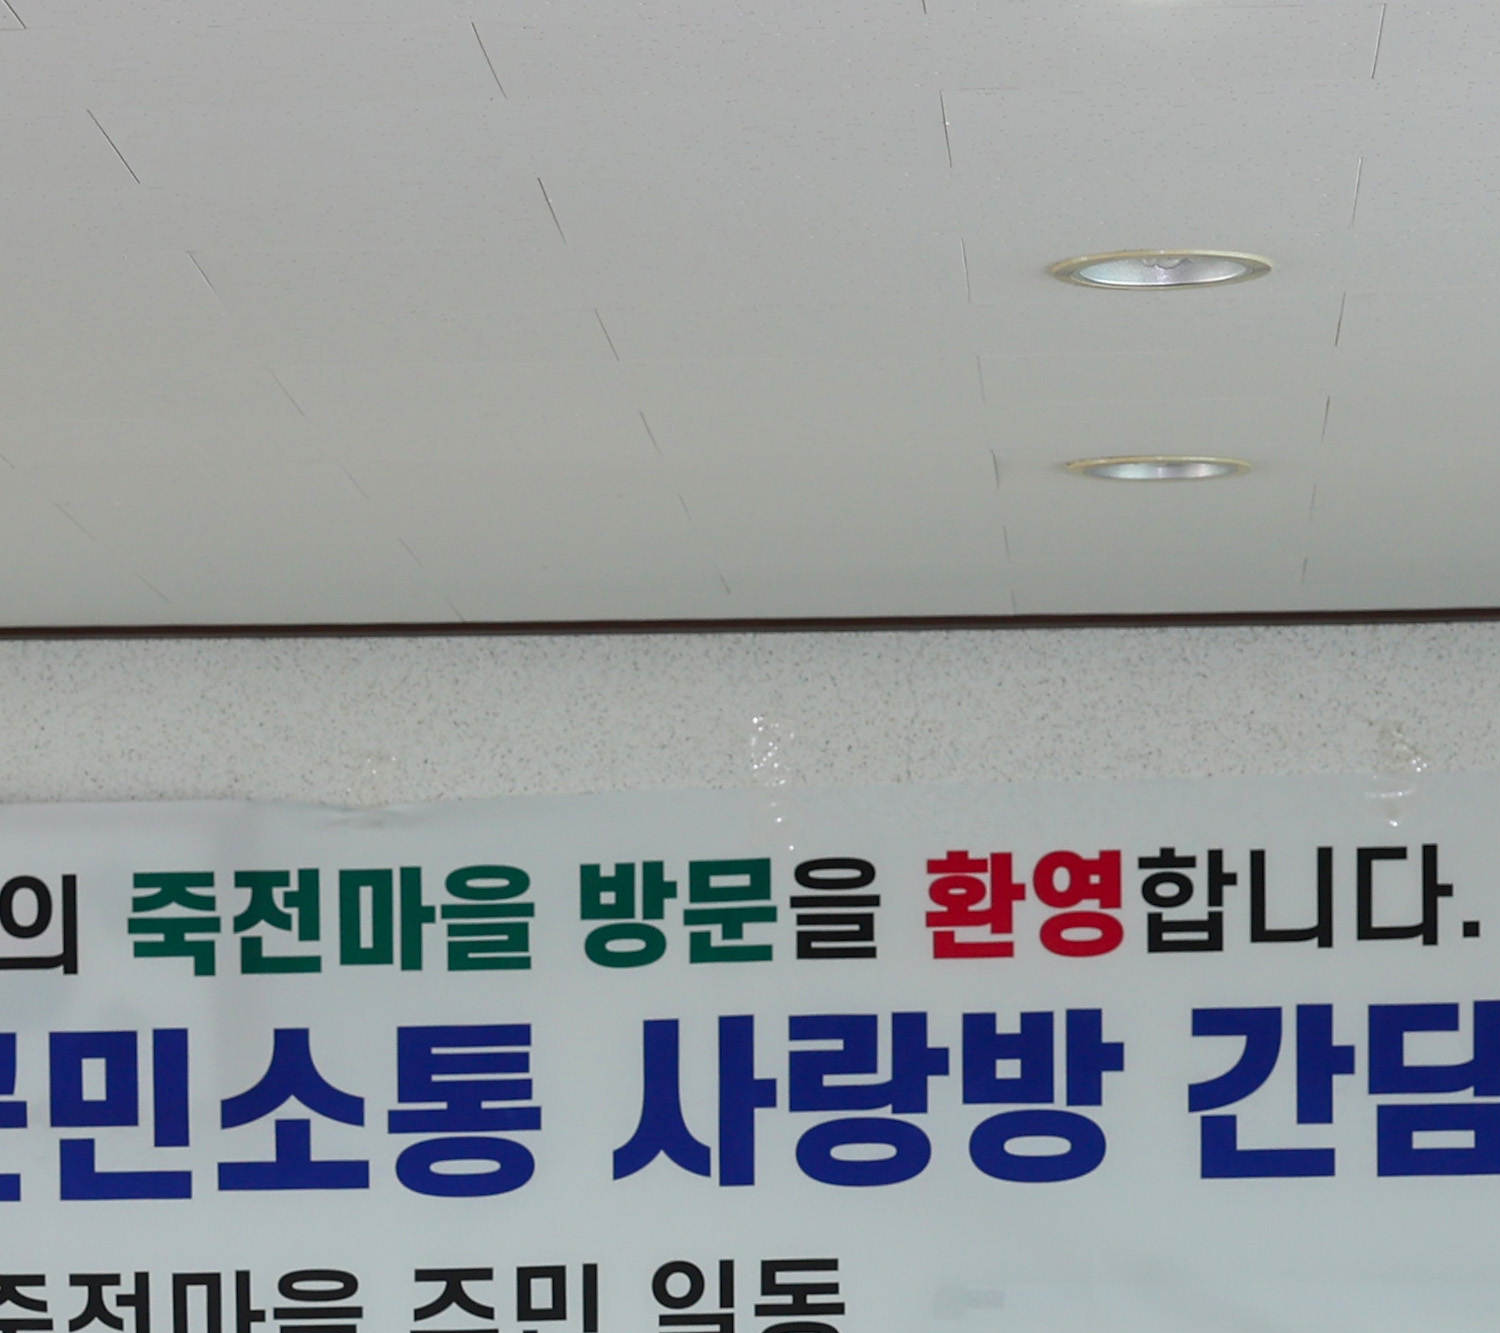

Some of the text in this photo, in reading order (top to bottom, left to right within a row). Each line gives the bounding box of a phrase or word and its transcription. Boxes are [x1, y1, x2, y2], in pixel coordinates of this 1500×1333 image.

[127, 864, 536, 977] 죽전마을
[579, 856, 881, 969] 방문을
[925, 843, 1481, 960] 환영합니다.
[611, 1008, 1125, 1187] 사랑방
